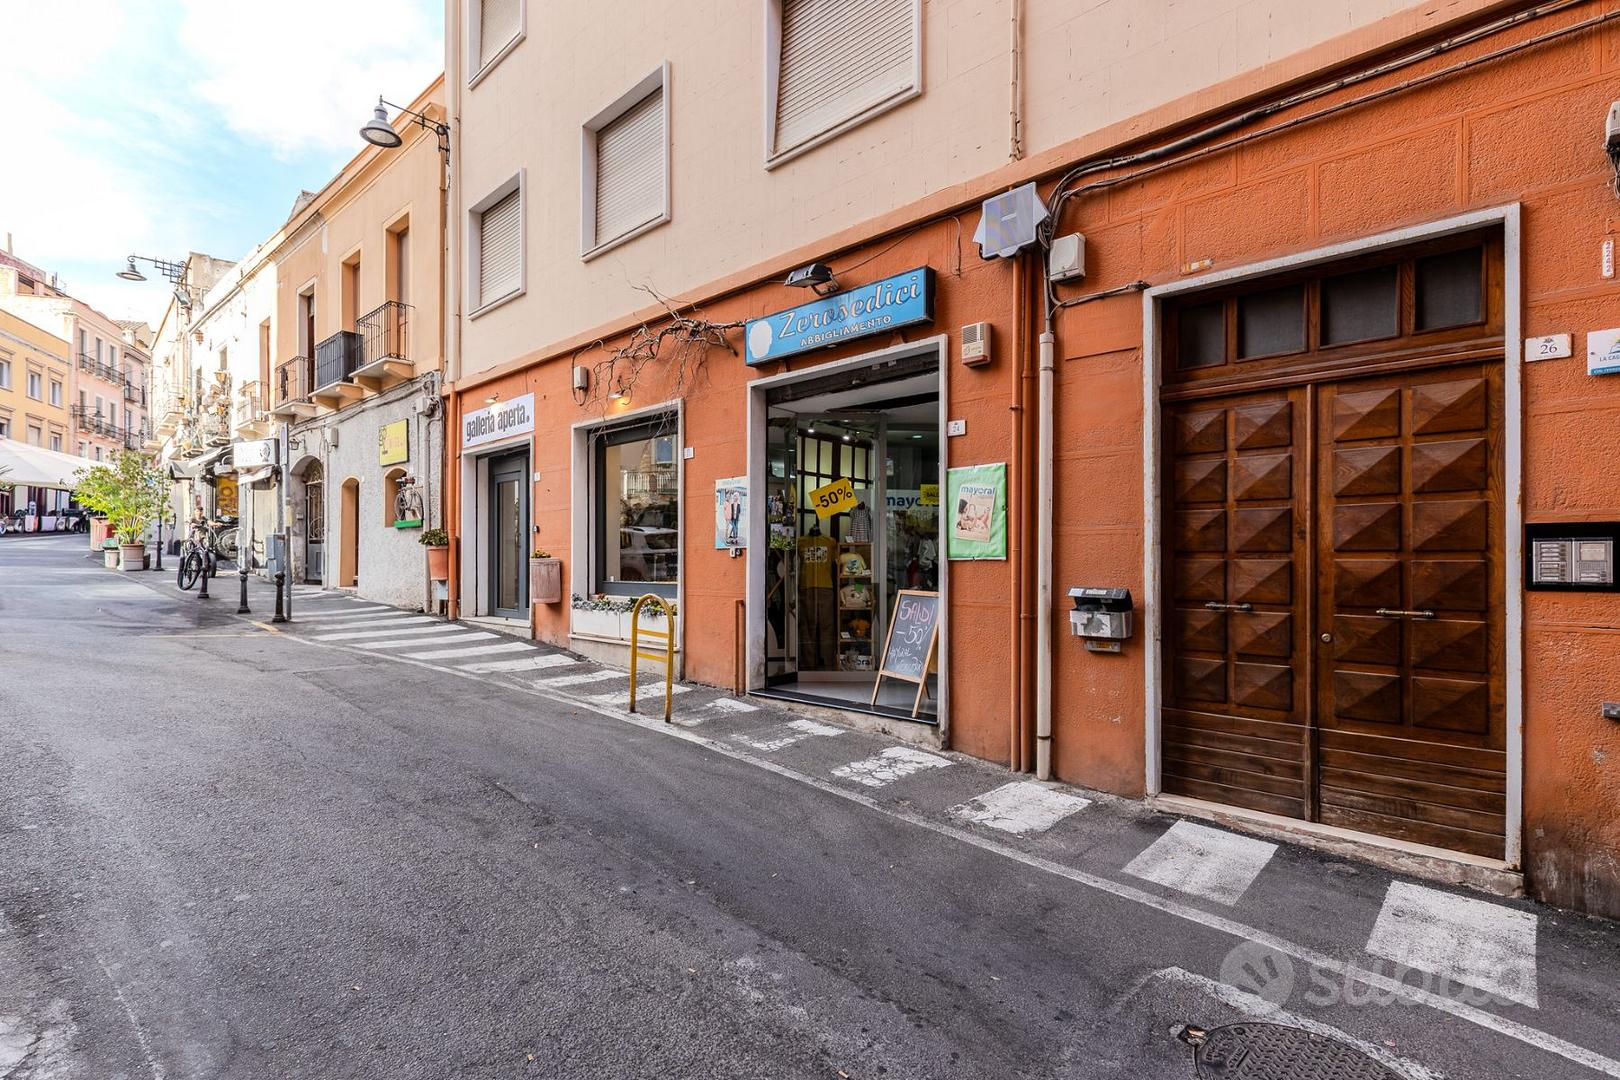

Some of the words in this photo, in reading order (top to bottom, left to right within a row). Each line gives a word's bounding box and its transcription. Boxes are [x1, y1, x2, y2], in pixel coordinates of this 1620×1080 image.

[778, 275, 922, 339] Zerosedici
[800, 314, 892, 347] ABBIGLIAMENTO
[1539, 343, 1558, 355] 26
[466, 411, 496, 441] galleria
[497, 403, 530, 432] aperta.
[815, 485, 853, 509] -50%
[960, 486, 995, 496] mayoral
